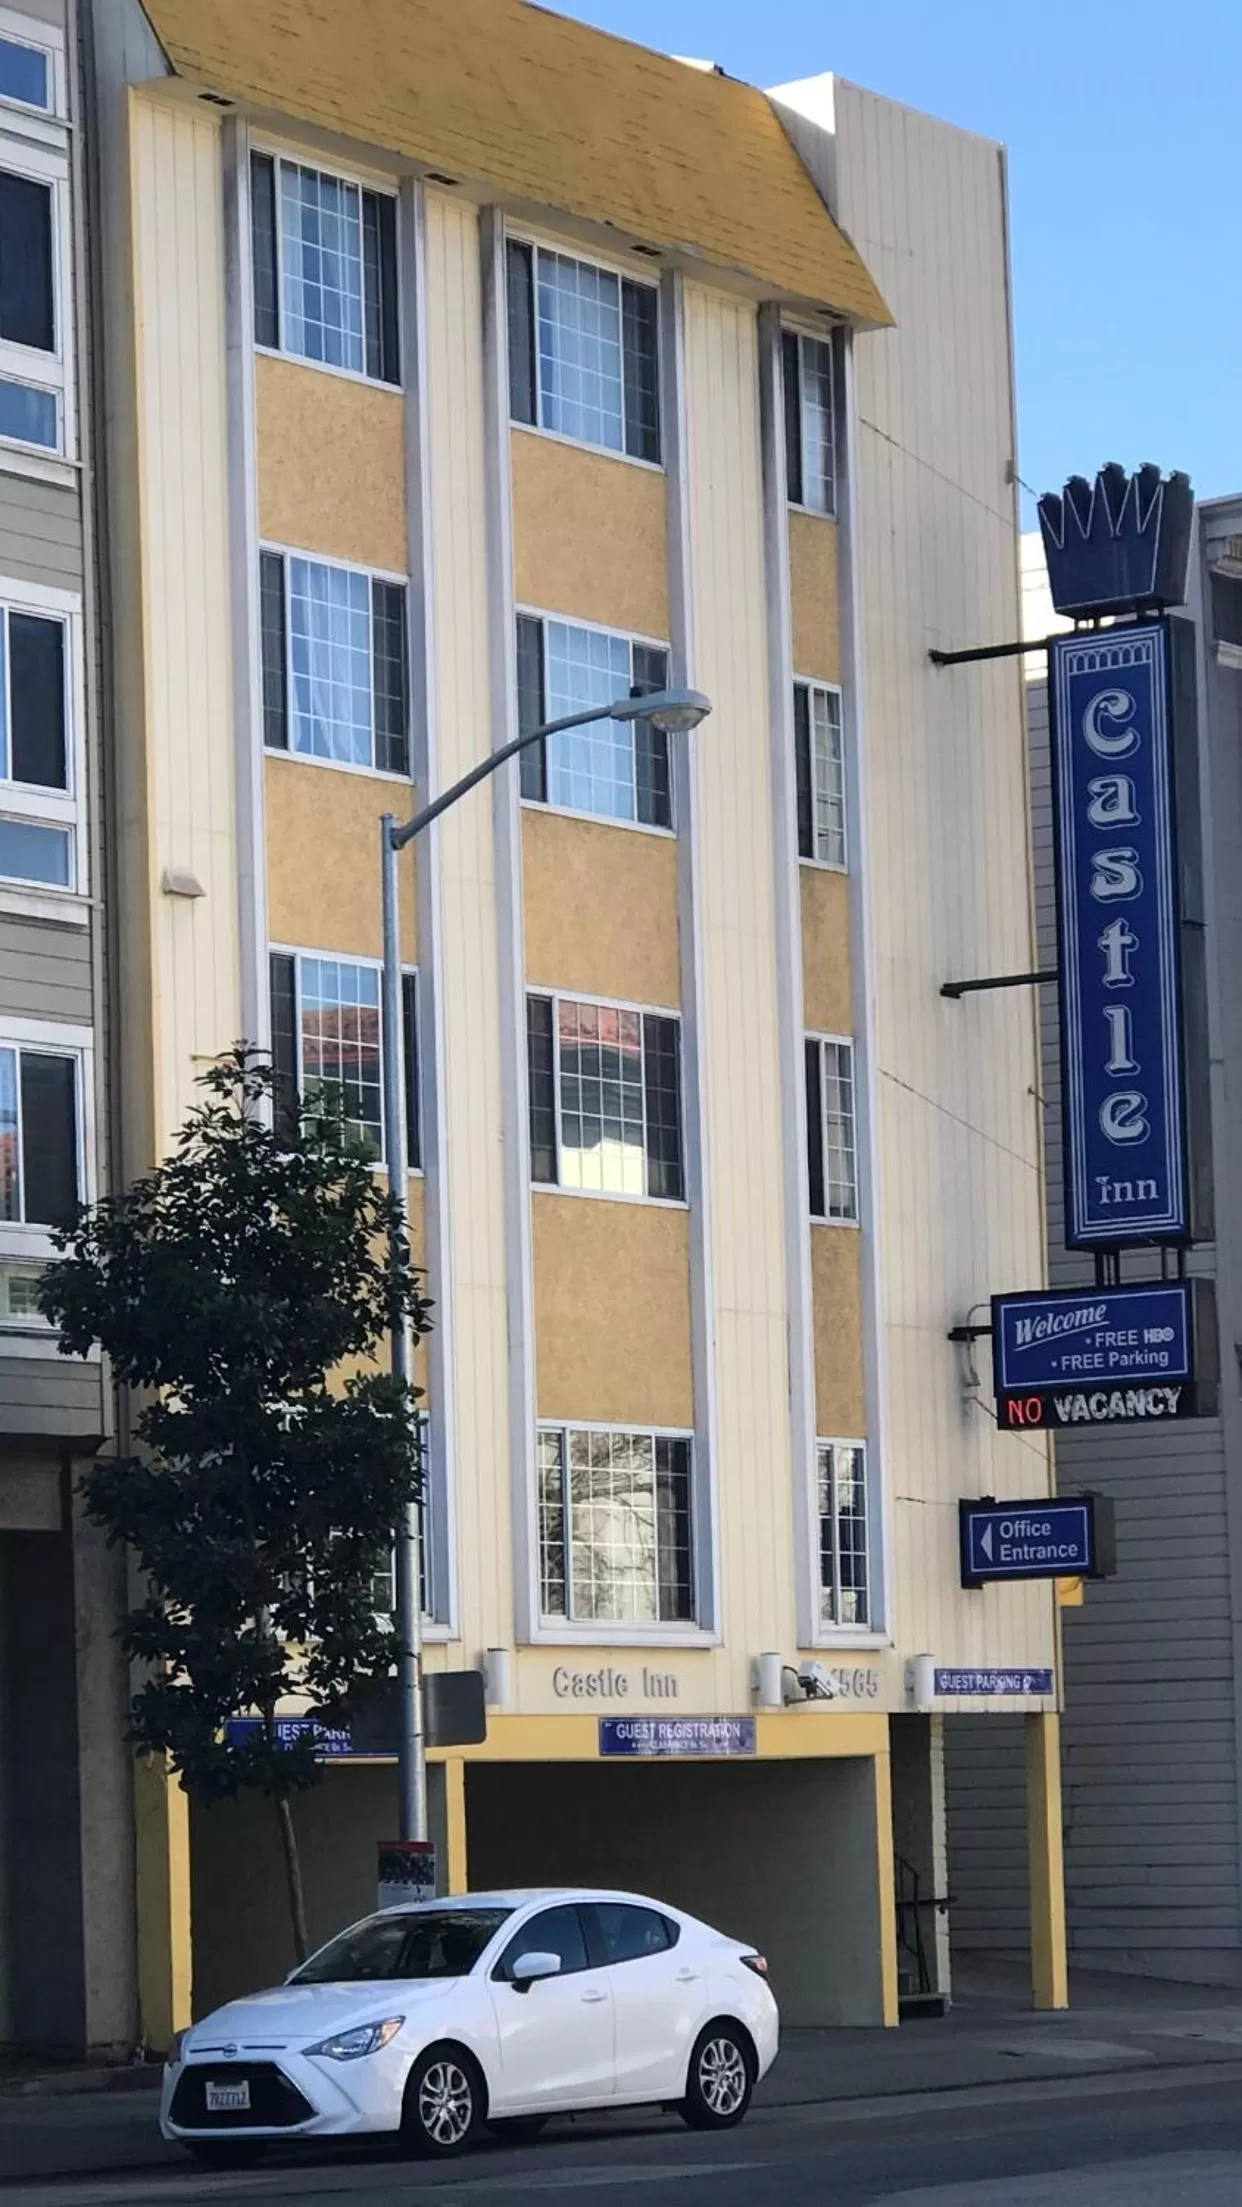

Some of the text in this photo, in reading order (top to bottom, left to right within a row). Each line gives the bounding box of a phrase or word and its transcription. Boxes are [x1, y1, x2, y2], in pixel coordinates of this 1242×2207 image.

[1083, 688, 1150, 1146] Castle
[1015, 1304, 1107, 1345] Welcome
[1095, 1327, 1175, 1348] FREE HBO
[1061, 1349, 1169, 1371] FREE Parking
[1008, 1386, 1182, 1425] NO VACANCY
[1000, 1521, 1052, 1539] Office
[1000, 1543, 1079, 1562] Entrance
[553, 1665, 678, 1698] Castle Inn
[940, 1674, 974, 1689] GUEST
[616, 1722, 741, 1739] GUEST REGISTRATION
